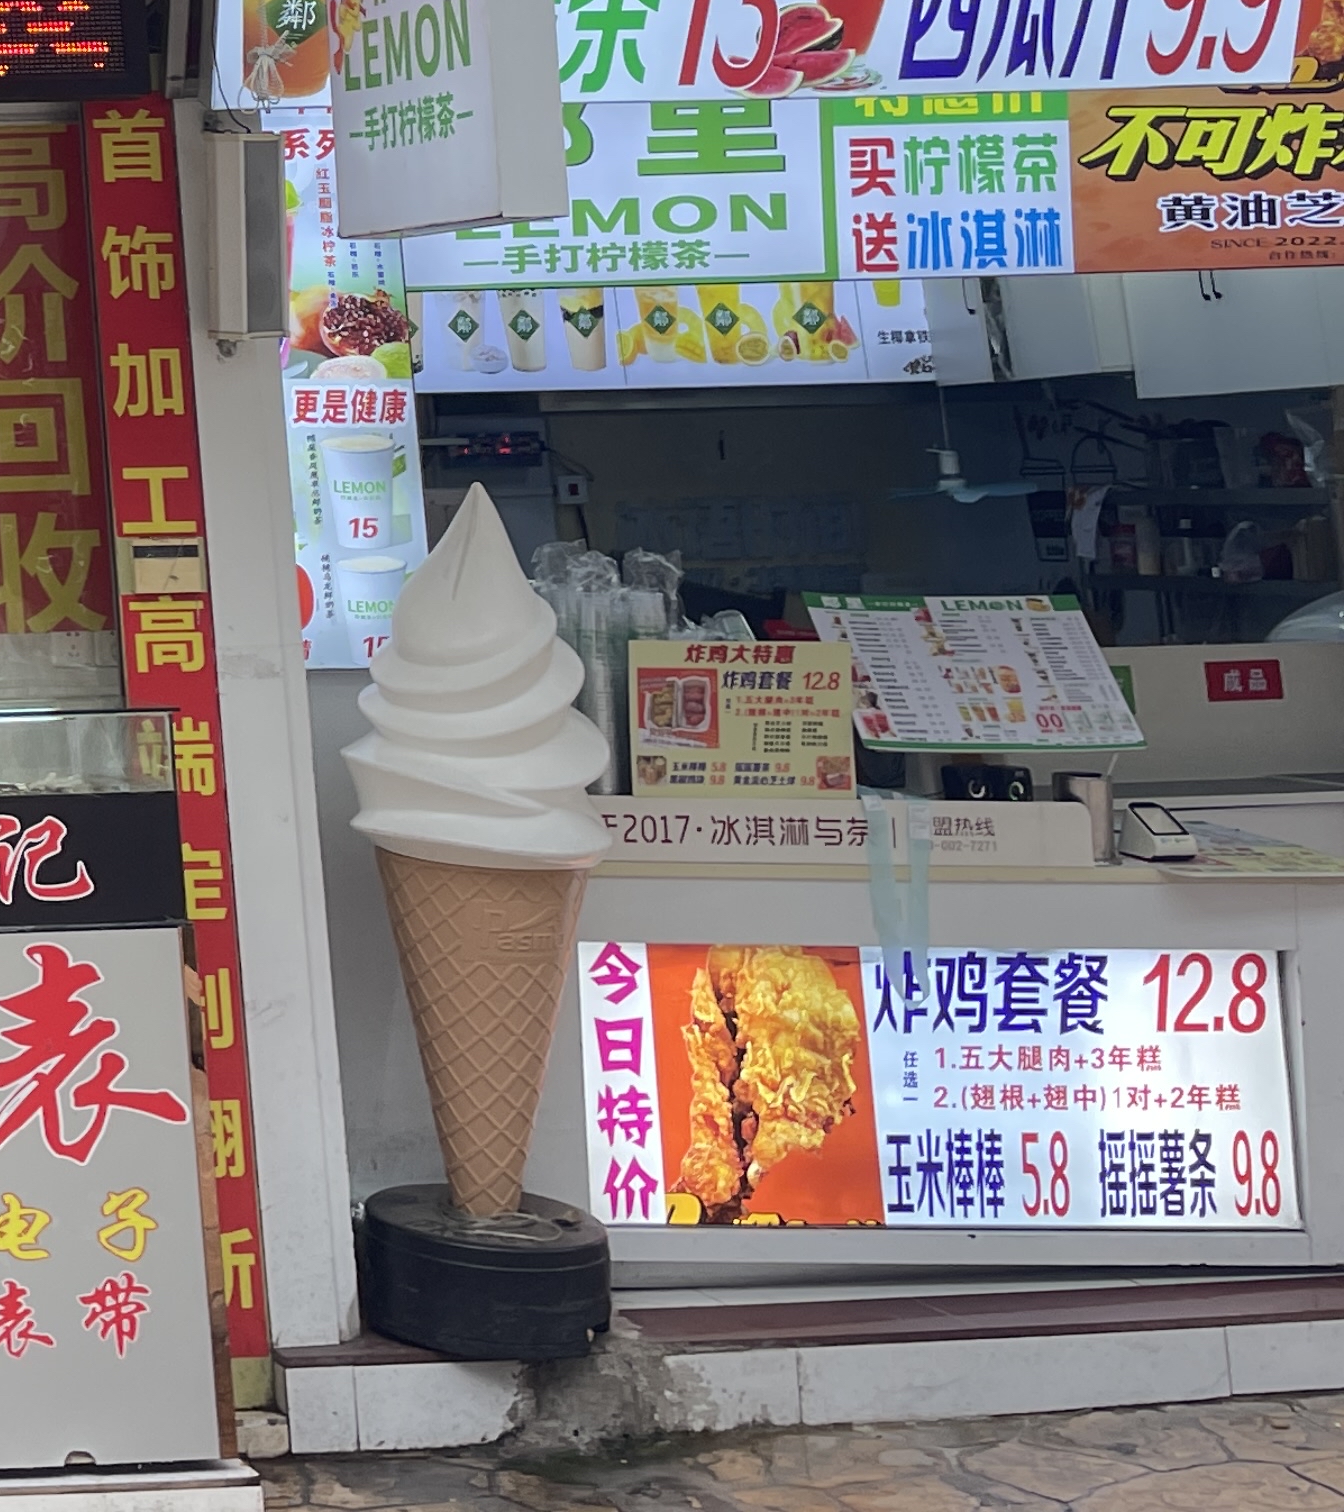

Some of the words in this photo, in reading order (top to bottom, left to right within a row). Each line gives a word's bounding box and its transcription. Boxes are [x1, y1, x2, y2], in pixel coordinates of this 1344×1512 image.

[563, 101, 787, 177] 里
[1078, 102, 1344, 182] 不可炸
[849, 133, 1059, 199] 买柠檬茶
[455, 193, 789, 240] MON
[852, 207, 1064, 273] 送冰淇淋
[1210, 238, 1265, 249] SINCE
[292, 388, 408, 425] 更是健康
[333, 479, 387, 494] LEMON
[348, 517, 379, 539] 15
[684, 644, 797, 665] 炸鸡大特惠
[722, 671, 793, 691] 炸鸡套餐
[801, 671, 842, 691] 12.8
[872, 949, 1110, 1036] 炸鸡套餐
[1142, 952, 1269, 1035] 12.8
[587, 941, 660, 1223] 今日特价
[902, 1050, 919, 1102] 任选一
[933, 1044, 1162, 1073] 1.五大腿肉+3年糕
[885, 1127, 1006, 1219] 玉米棒棒
[1019, 1130, 1072, 1219] 5.8
[1097, 1127, 1218, 1220] 摇摇薯条
[1232, 1129, 1283, 1220] 9.8
